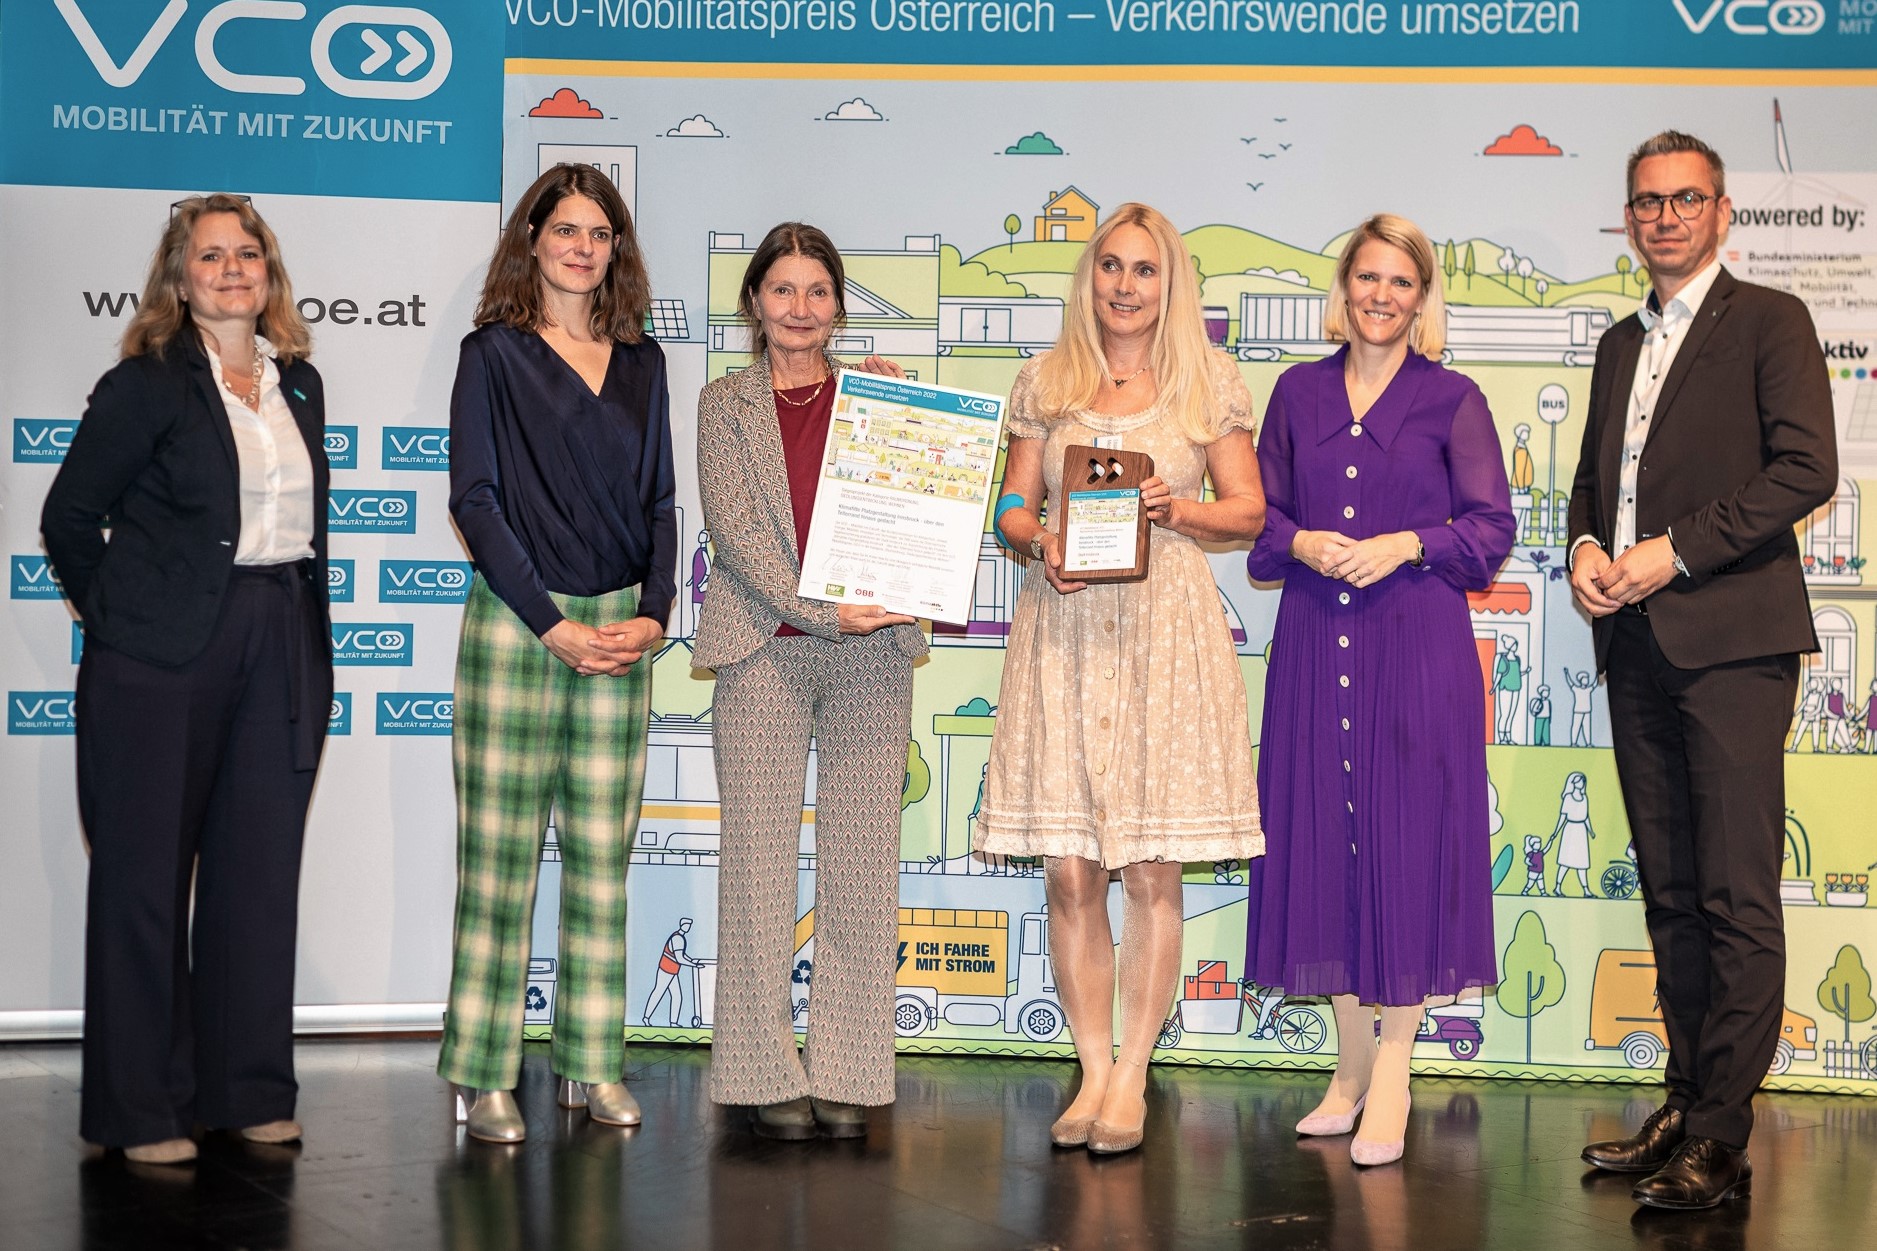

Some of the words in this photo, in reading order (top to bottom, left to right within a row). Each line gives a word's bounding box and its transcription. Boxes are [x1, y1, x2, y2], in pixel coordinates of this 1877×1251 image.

[1106, 0, 1388, 34] Verkehrswende
[1400, 0, 1580, 34] umsetzen
[53, 104, 228, 136] MOBILITÄT
[237, 112, 295, 138] MIT
[302, 115, 453, 145] ZUKUNFT
[1833, 205, 1865, 232] by:
[1748, 251, 1863, 262] Bundesministerium
[923, 390, 937, 399] 2022
[1542, 400, 1566, 409] BUS
[21, 426, 73, 447] VC
[16, 699, 77, 719] VC
[916, 942, 940, 955] ICH
[944, 943, 990, 957] FAHRE
[916, 958, 941, 971] MIT
[946, 959, 996, 973] STROM
